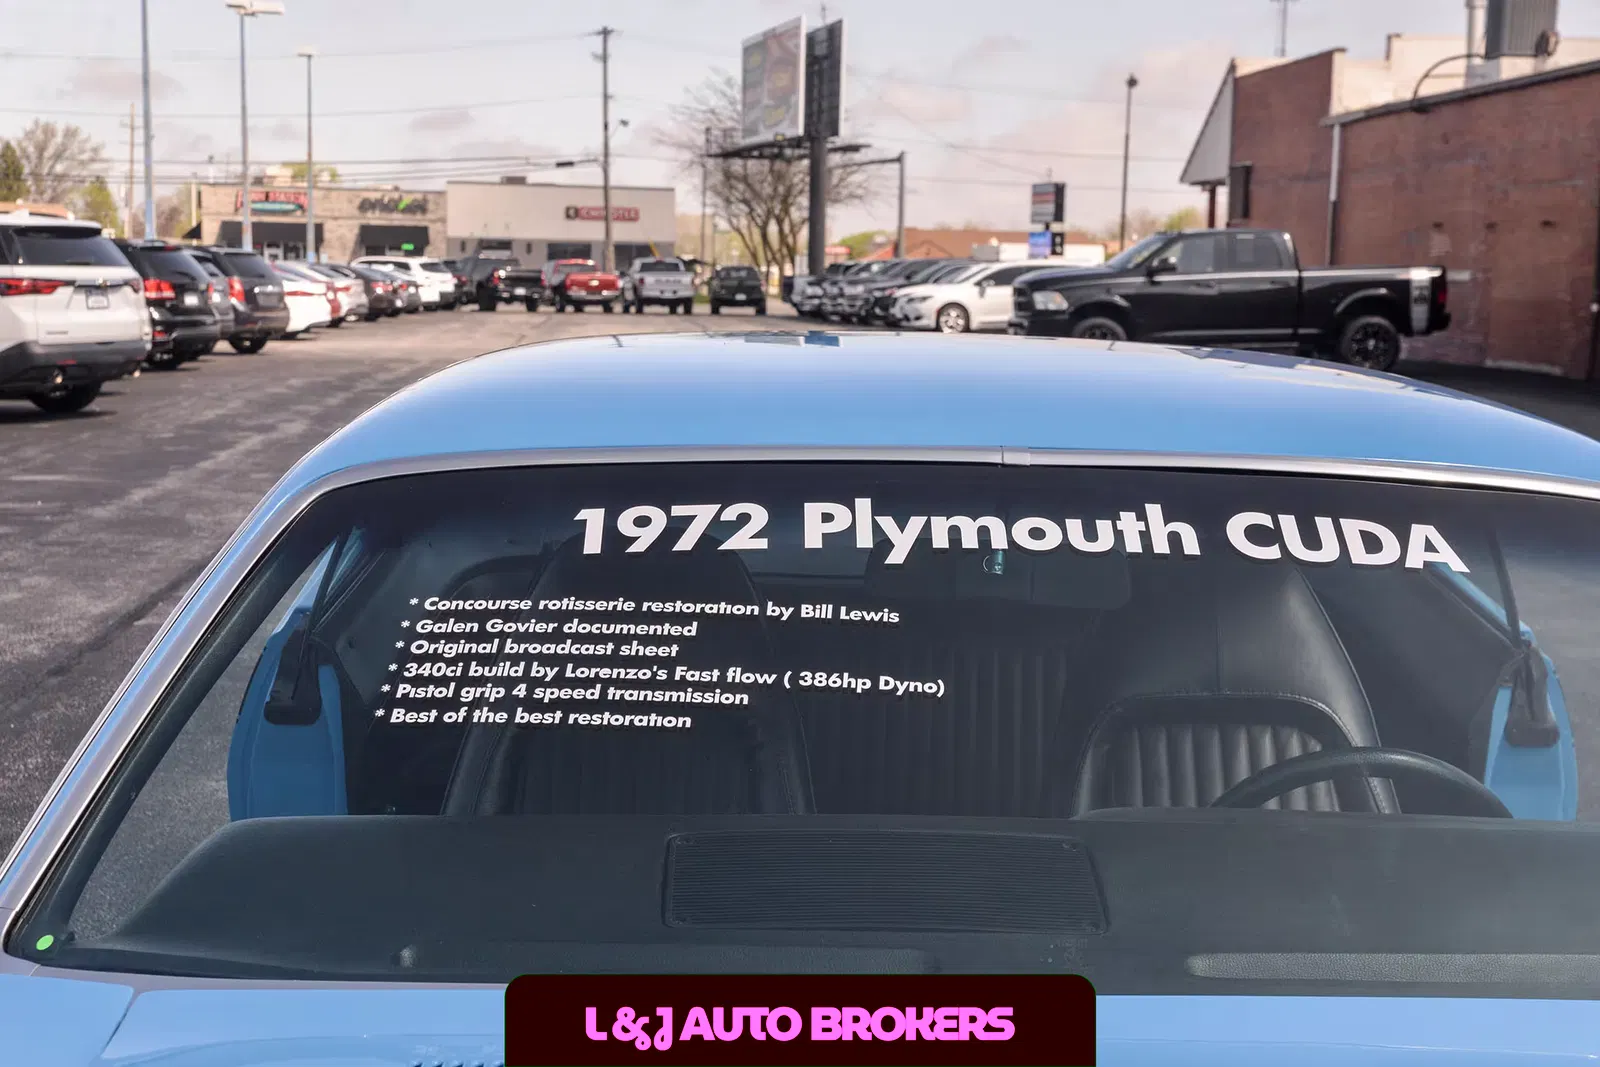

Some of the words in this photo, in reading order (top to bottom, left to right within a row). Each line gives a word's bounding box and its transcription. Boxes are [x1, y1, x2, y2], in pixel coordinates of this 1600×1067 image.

[573, 502, 769, 555] 1972
[803, 497, 1201, 565] Plymouth
[1225, 511, 1469, 572] CUDA
[423, 596, 533, 611] Concourse
[538, 597, 636, 612] rotisserie
[641, 601, 760, 616] restoration
[766, 601, 795, 621] by
[800, 603, 834, 619] Bill
[839, 605, 901, 623] Lewis
[415, 618, 479, 634] Galen
[485, 618, 559, 633] Govier
[562, 618, 698, 637] documented
[410, 638, 500, 658] Original
[503, 638, 615, 655] broadcast
[618, 640, 680, 657] sheet
[403, 661, 464, 678] 340ci
[468, 660, 526, 677] build
[529, 661, 560, 682] by
[564, 663, 668, 681] Lorenzo's
[674, 665, 721, 682] Fast
[726, 666, 778, 685] flow
[798, 671, 872, 694] 386hp
[878, 675, 945, 698] Dyno)
[395, 681, 456, 699] Pistol
[459, 682, 506, 703] grip
[511, 683, 527, 698] 4
[532, 683, 602, 703] speed
[606, 686, 749, 705] transmission
[389, 708, 439, 723] Best
[442, 706, 469, 723] of
[472, 706, 509, 724] the
[514, 706, 563, 724] best
[567, 711, 692, 728] restoration
